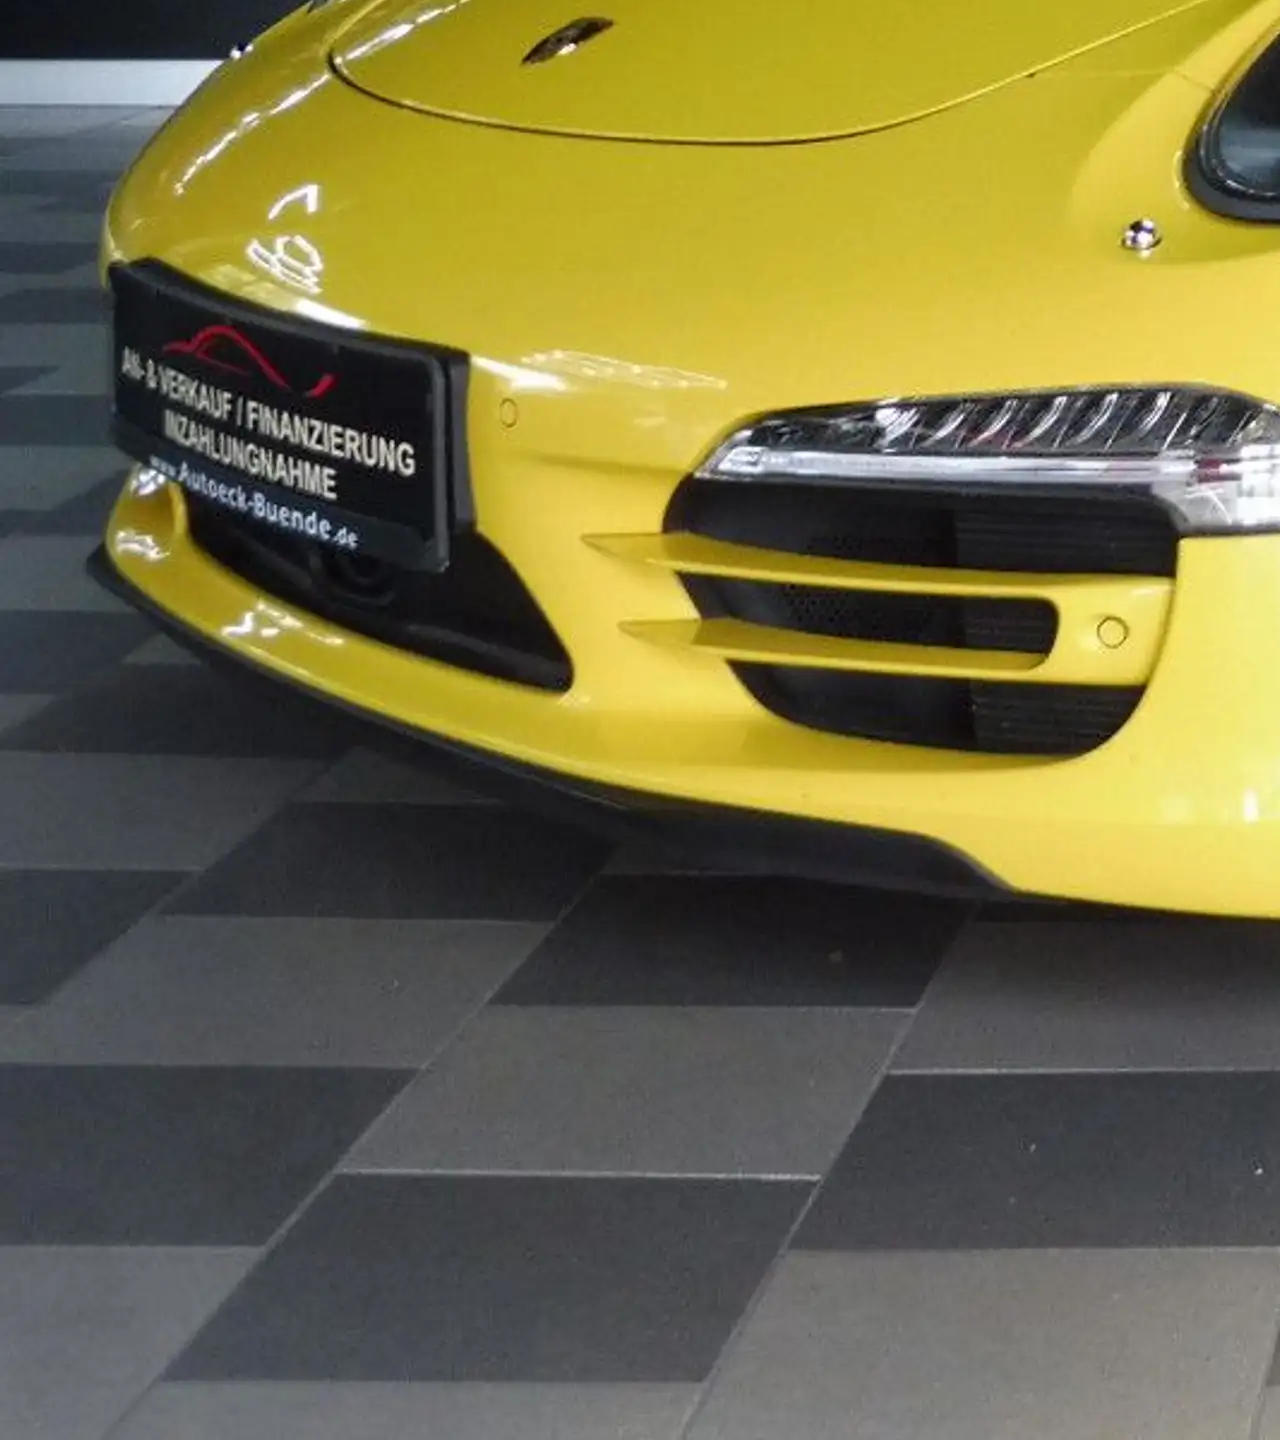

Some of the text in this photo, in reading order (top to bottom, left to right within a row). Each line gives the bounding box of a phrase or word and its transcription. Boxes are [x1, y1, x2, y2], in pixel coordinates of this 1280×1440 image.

[157, 364, 232, 421] VERKAUF
[245, 399, 416, 477] FINANZIERUNG
[164, 409, 338, 500] INZAHLUNGNAHME
